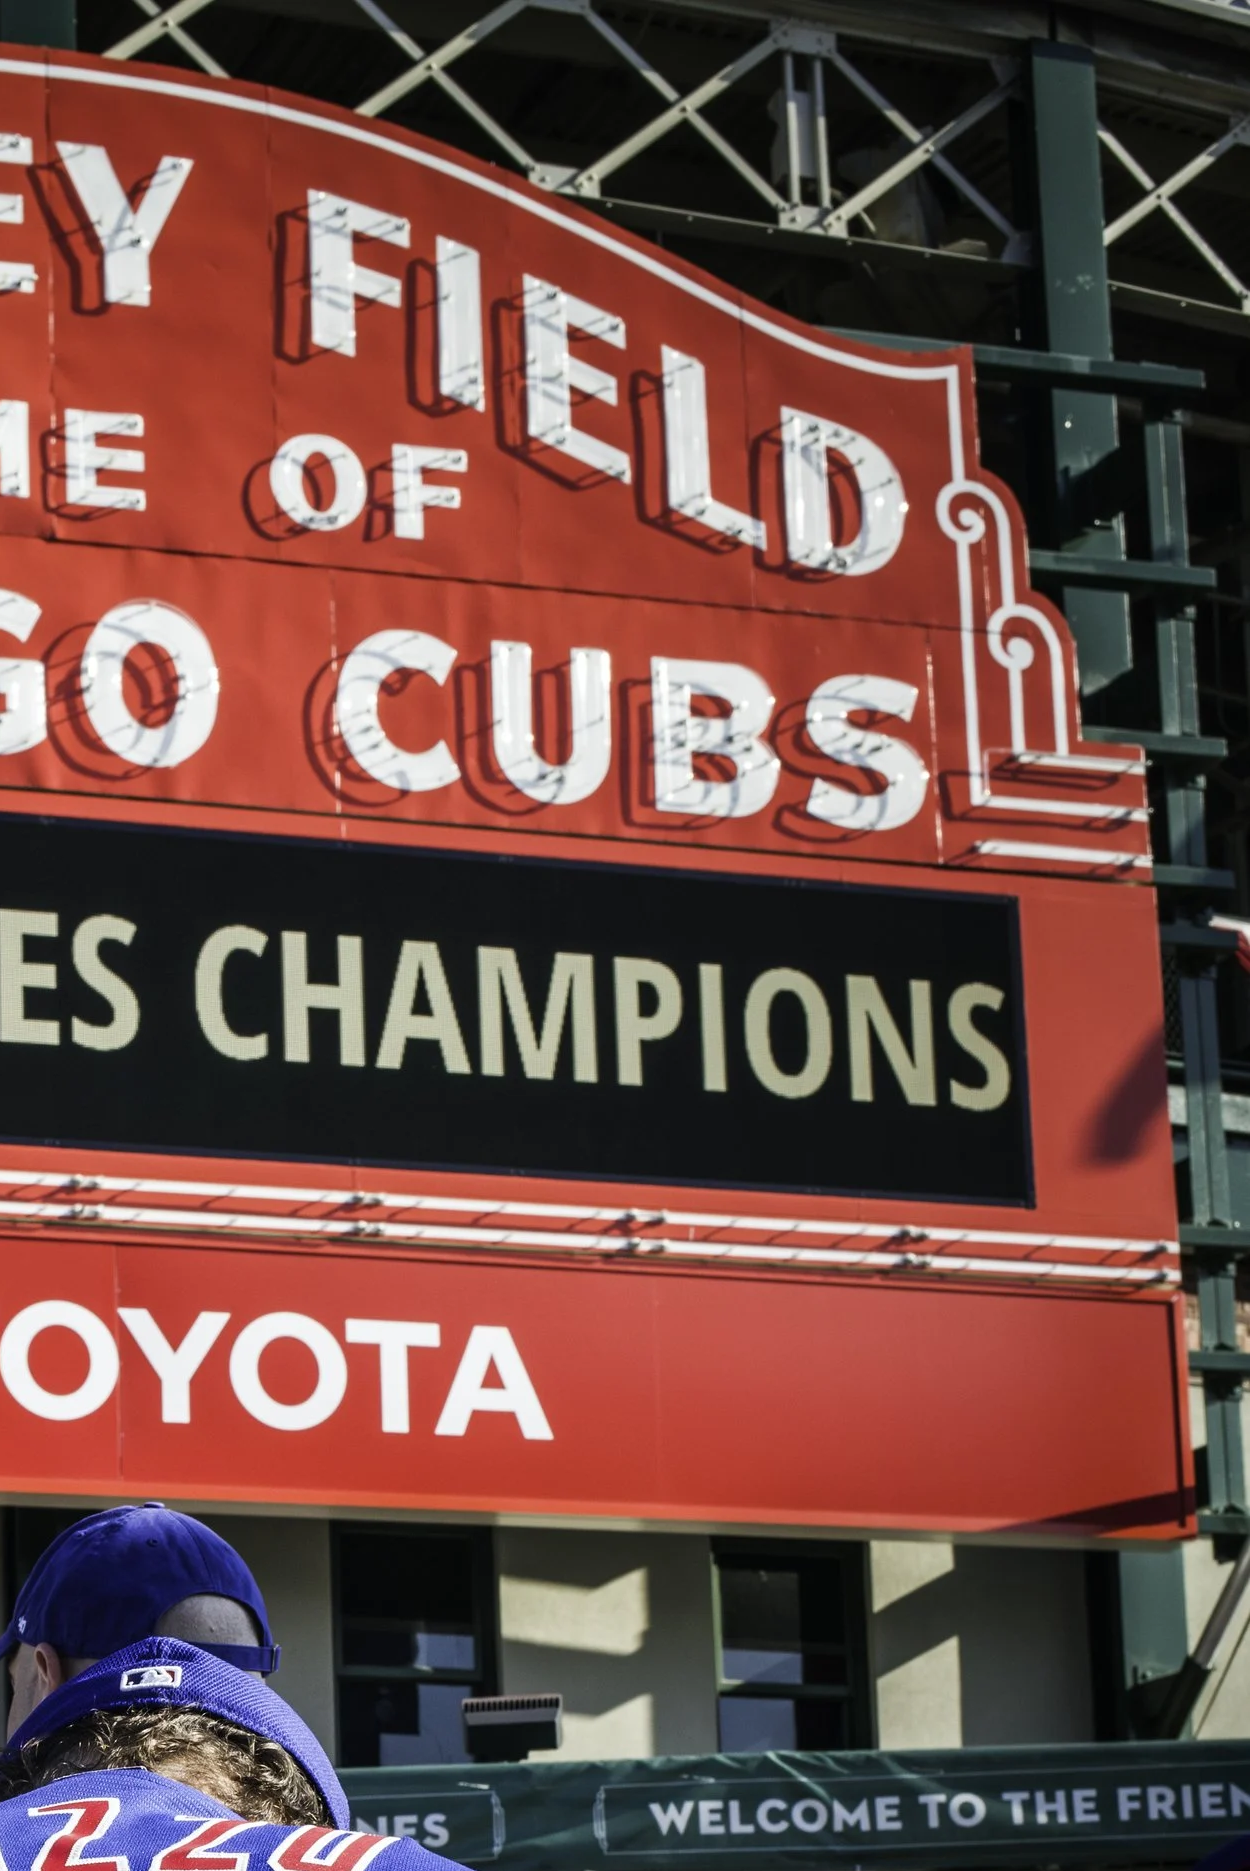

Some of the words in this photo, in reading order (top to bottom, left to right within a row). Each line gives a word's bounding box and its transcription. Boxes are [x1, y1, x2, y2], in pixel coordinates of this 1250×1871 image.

[307, 188, 908, 577] FIELD
[270, 434, 469, 539] OF
[336, 628, 930, 832] CUBS
[195, 924, 1011, 1113] CHAMPIONS
[648, 1796, 903, 1836] WELCOME
[918, 1793, 987, 1828] TO
[1001, 1788, 1101, 1826] THE
